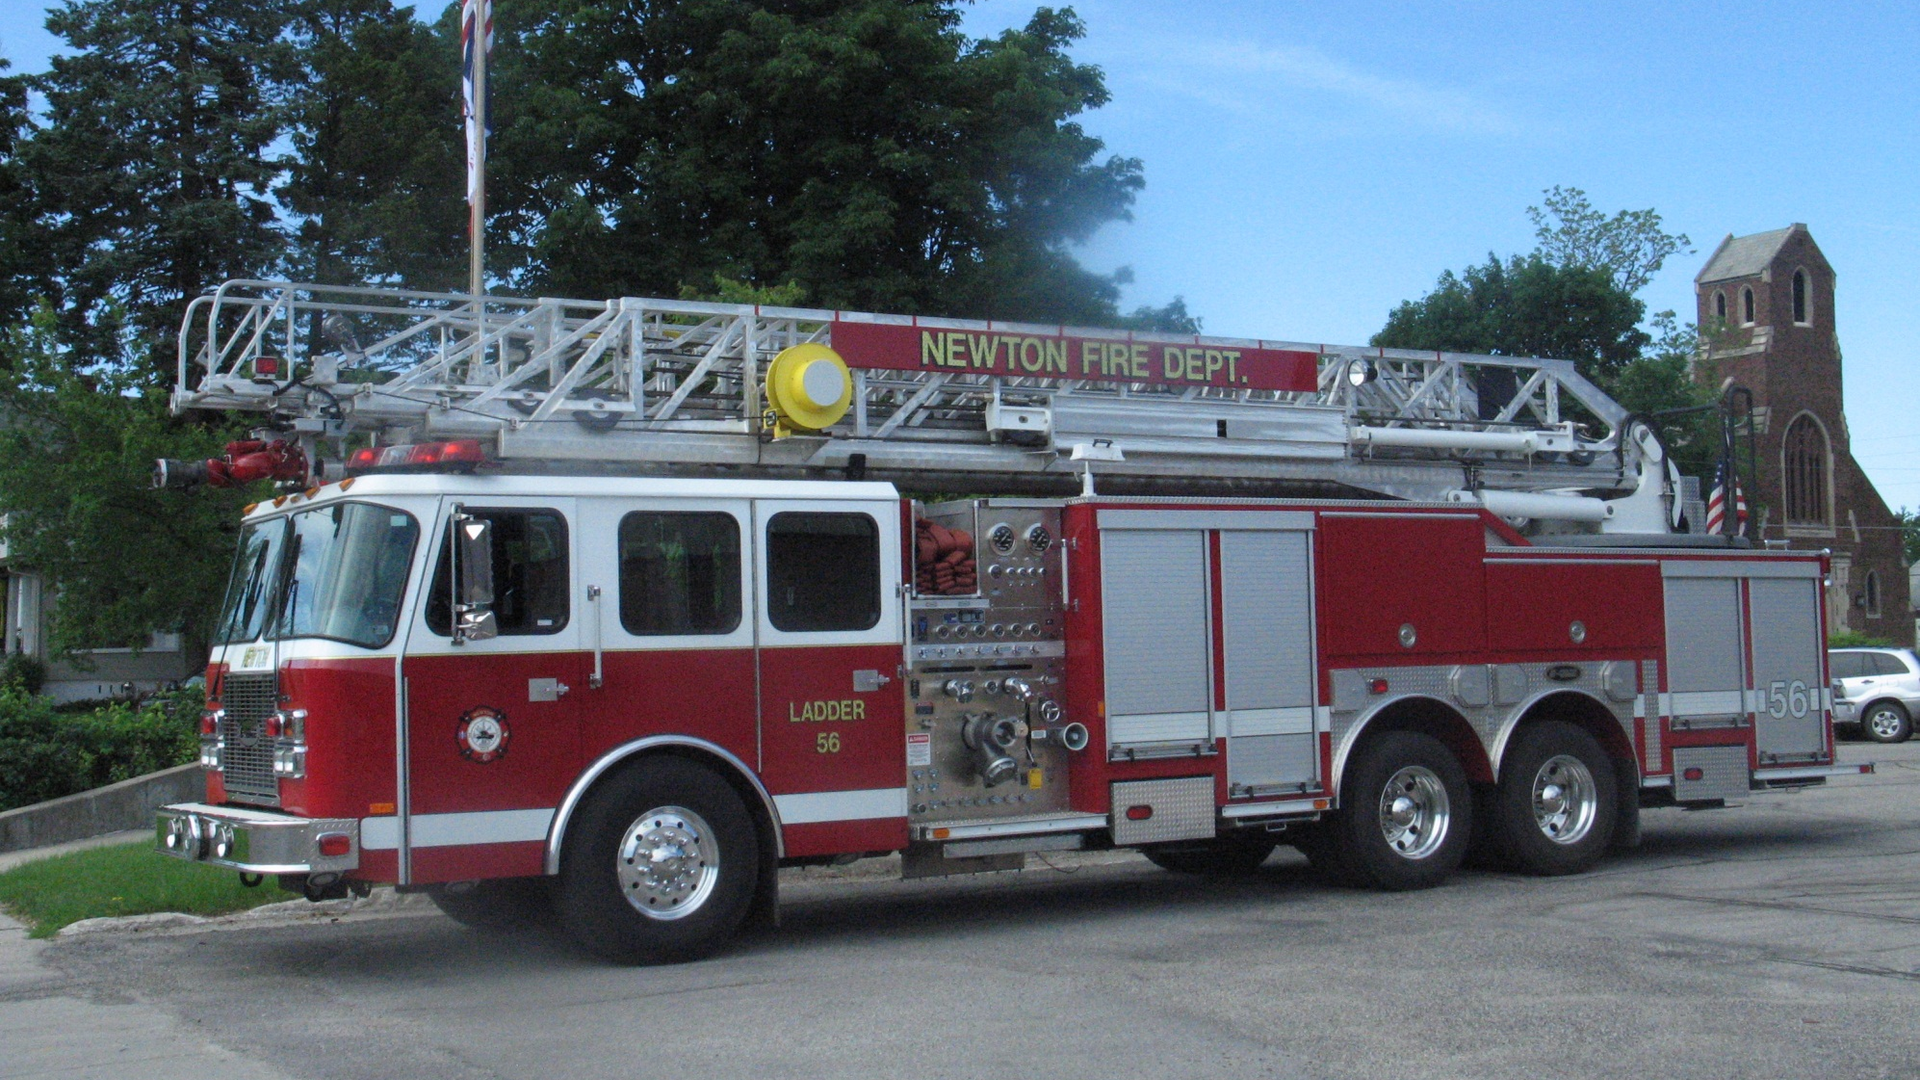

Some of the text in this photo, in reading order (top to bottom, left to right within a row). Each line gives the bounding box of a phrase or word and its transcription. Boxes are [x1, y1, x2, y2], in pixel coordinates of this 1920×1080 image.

[921, 330, 1249, 384] NEWTON FIRE DEPT.
[789, 700, 865, 722] LADDER
[1768, 679, 1808, 719] 56
[817, 732, 840, 753] 56
